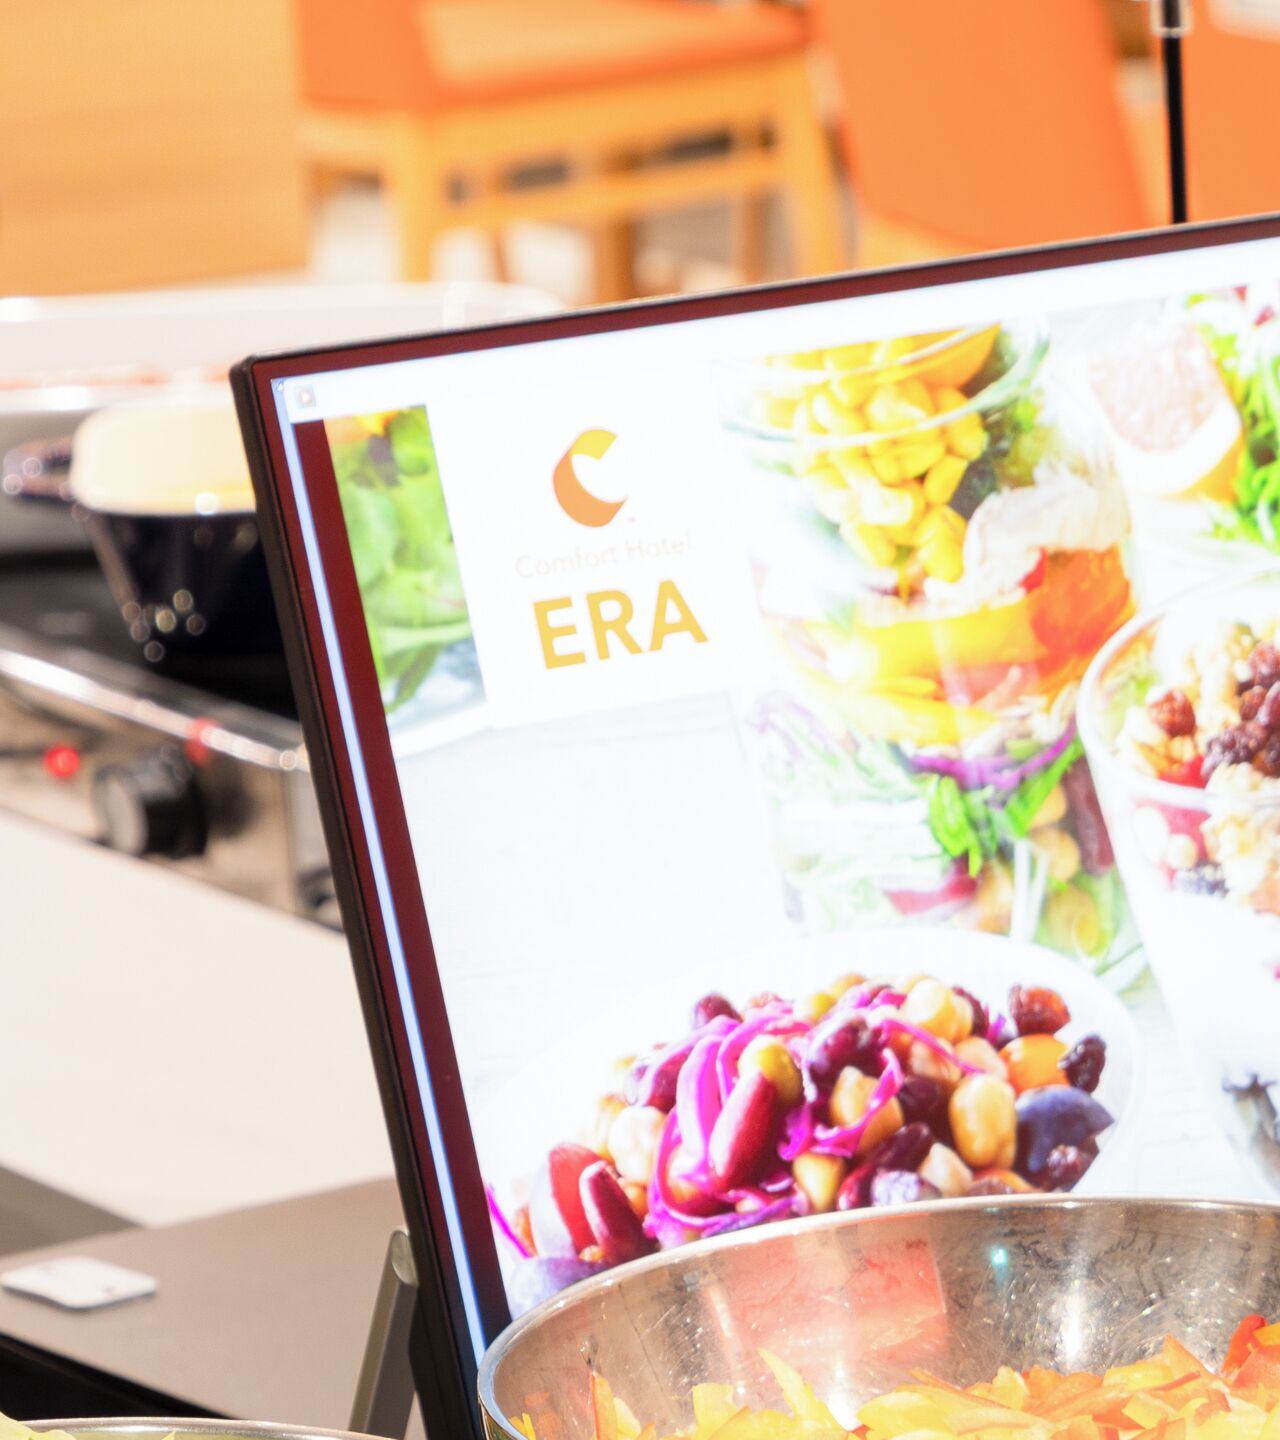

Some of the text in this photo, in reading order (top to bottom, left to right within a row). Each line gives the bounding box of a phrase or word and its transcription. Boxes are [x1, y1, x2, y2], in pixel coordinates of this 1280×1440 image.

[515, 528, 692, 579] Comfort Hotel
[533, 578, 709, 669] ERA
